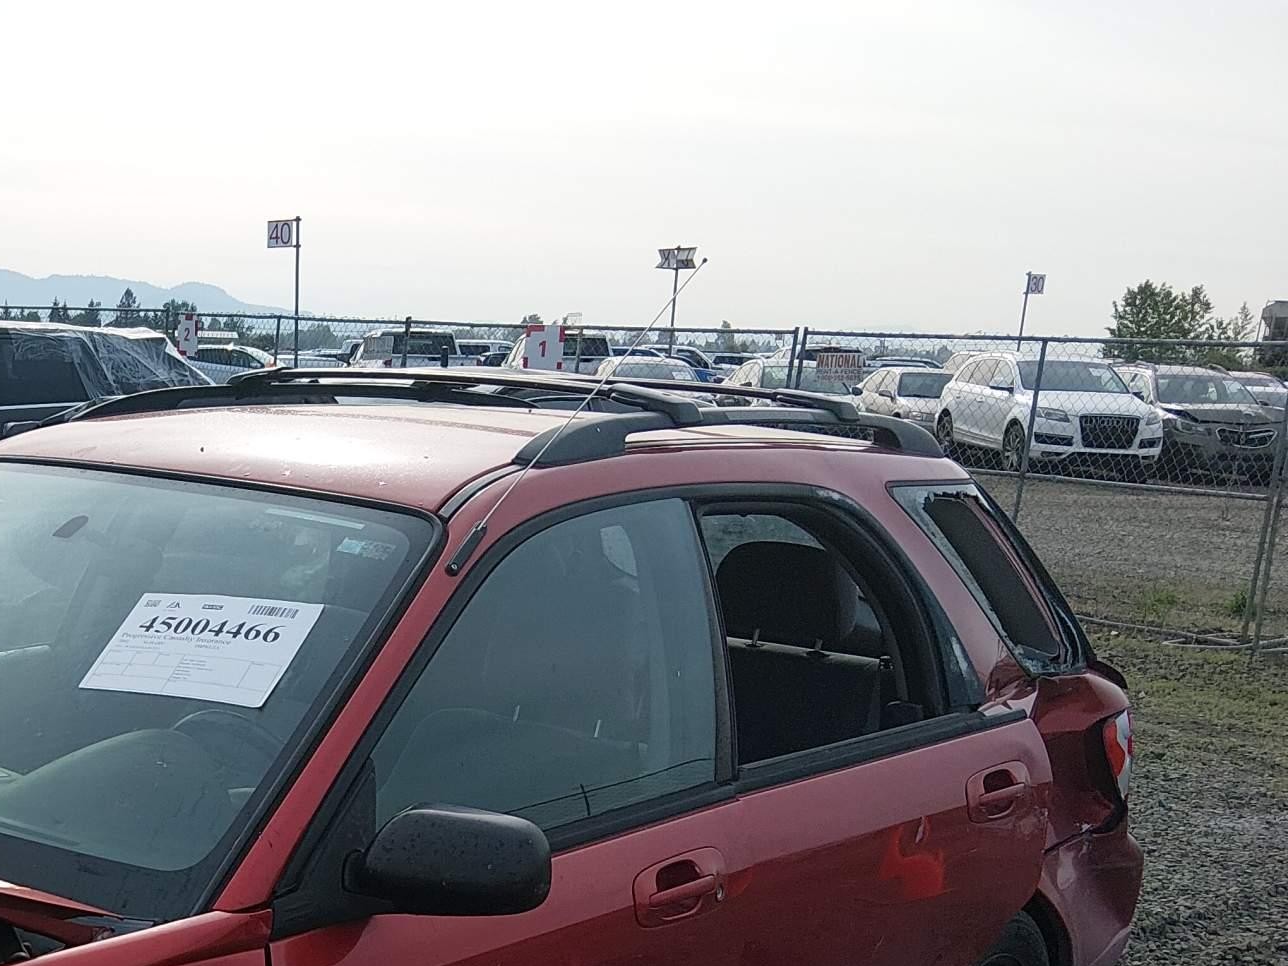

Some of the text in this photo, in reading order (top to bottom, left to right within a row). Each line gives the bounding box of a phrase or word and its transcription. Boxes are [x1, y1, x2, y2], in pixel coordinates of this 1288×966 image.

[269, 222, 291, 245] 40
[1030, 275, 1045, 293] 30
[183, 327, 190, 341] 2
[538, 340, 547, 358] 1
[817, 353, 862, 369] NATIONAL
[139, 615, 287, 644] 45004466
[196, 636, 232, 646] Insurance
